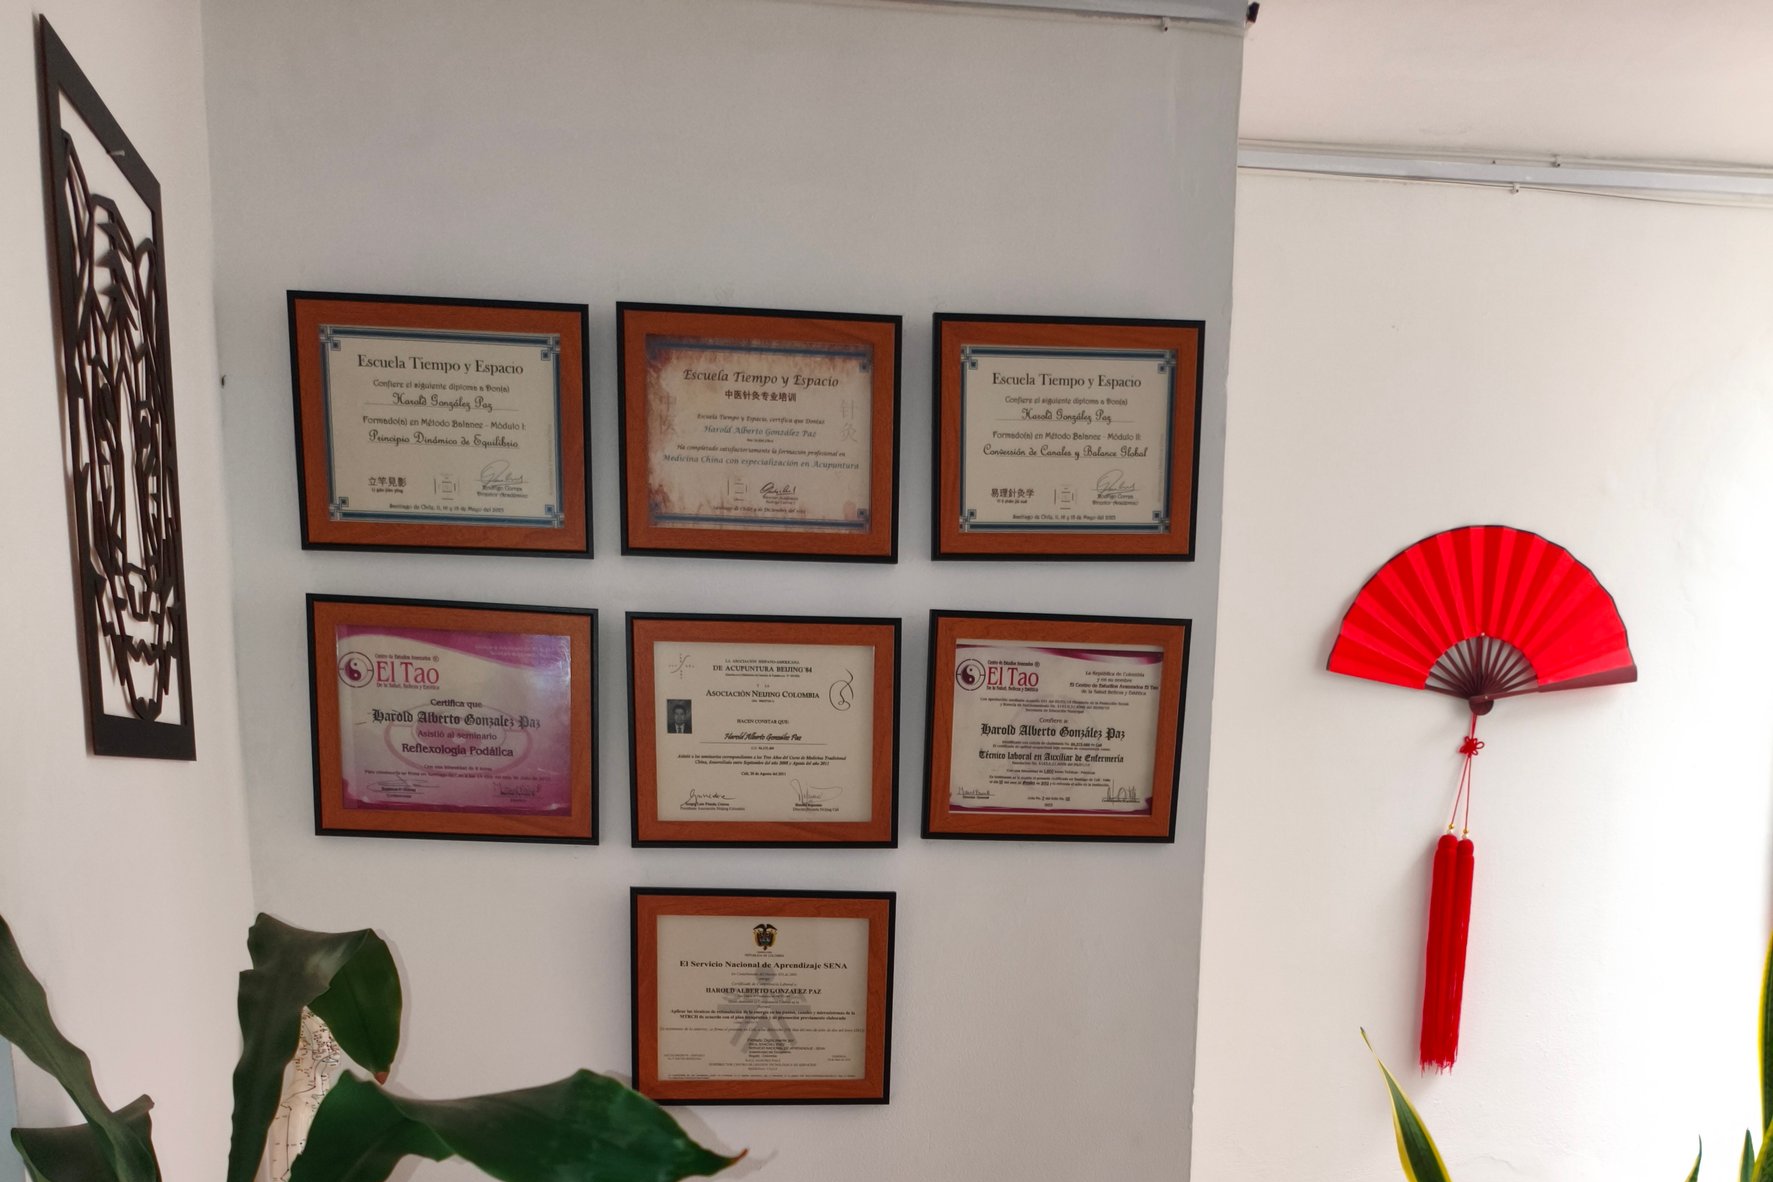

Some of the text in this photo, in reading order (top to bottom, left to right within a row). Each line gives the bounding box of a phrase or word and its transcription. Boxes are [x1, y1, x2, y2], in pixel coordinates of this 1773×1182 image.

[357, 354, 523, 376] Escuela Tiempo y Espacio
[373, 379, 404, 389] Confiere
[683, 369, 839, 389] Escuela Tiempo y Espacio
[992, 372, 1142, 390] Escuela Tiempo y Espacio
[392, 392, 493, 412] Harold González Paz
[725, 390, 797, 402] 中医针灸专业培训
[362, 415, 408, 427] Formado(a)
[421, 417, 450, 427] Método
[452, 420, 482, 428] Balance
[490, 421, 519, 430] Módulo
[1021, 408, 1112, 425] Harold González Paz
[369, 429, 519, 449] Principio Dinámico de Equilibrio
[704, 425, 732, 434] Harold
[735, 426, 763, 435] Alberto
[765, 427, 800, 437] González
[992, 431, 1033, 440] Formado(a)
[1045, 431, 1071, 440] Método
[1072, 432, 1101, 441] Balance
[1107, 433, 1134, 441] Módulo
[983, 443, 1148, 460] Conversión de Canales y Balance Global
[663, 454, 699, 463] Medicina
[700, 455, 724, 464] China
[725, 457, 739, 465] con
[741, 456, 798, 468] especialización
[813, 459, 859, 470] Acupuntura
[376, 661, 440, 685] El Tao
[987, 666, 1039, 687] El Tao
[782, 690, 820, 698] COLOMBIA
[430, 698, 483, 709] Certifica que
[372, 708, 413, 724] Harold
[417, 710, 461, 725] Alberto
[518, 715, 541, 730] Paz
[417, 730, 445, 738] Asistió
[457, 731, 498, 740] seminario
[981, 723, 1125, 741] Harold Alberto González Paz
[470, 745, 514, 757] Podálica
[979, 750, 1005, 759] Técnico
[1044, 752, 1072, 761] Auxiliar
[1074, 753, 1081, 761] de
[690, 960, 723, 968] Servicio
[725, 961, 760, 969] Nacional
[774, 962, 822, 970] Aprendizaje
[823, 962, 848, 970] SENA
